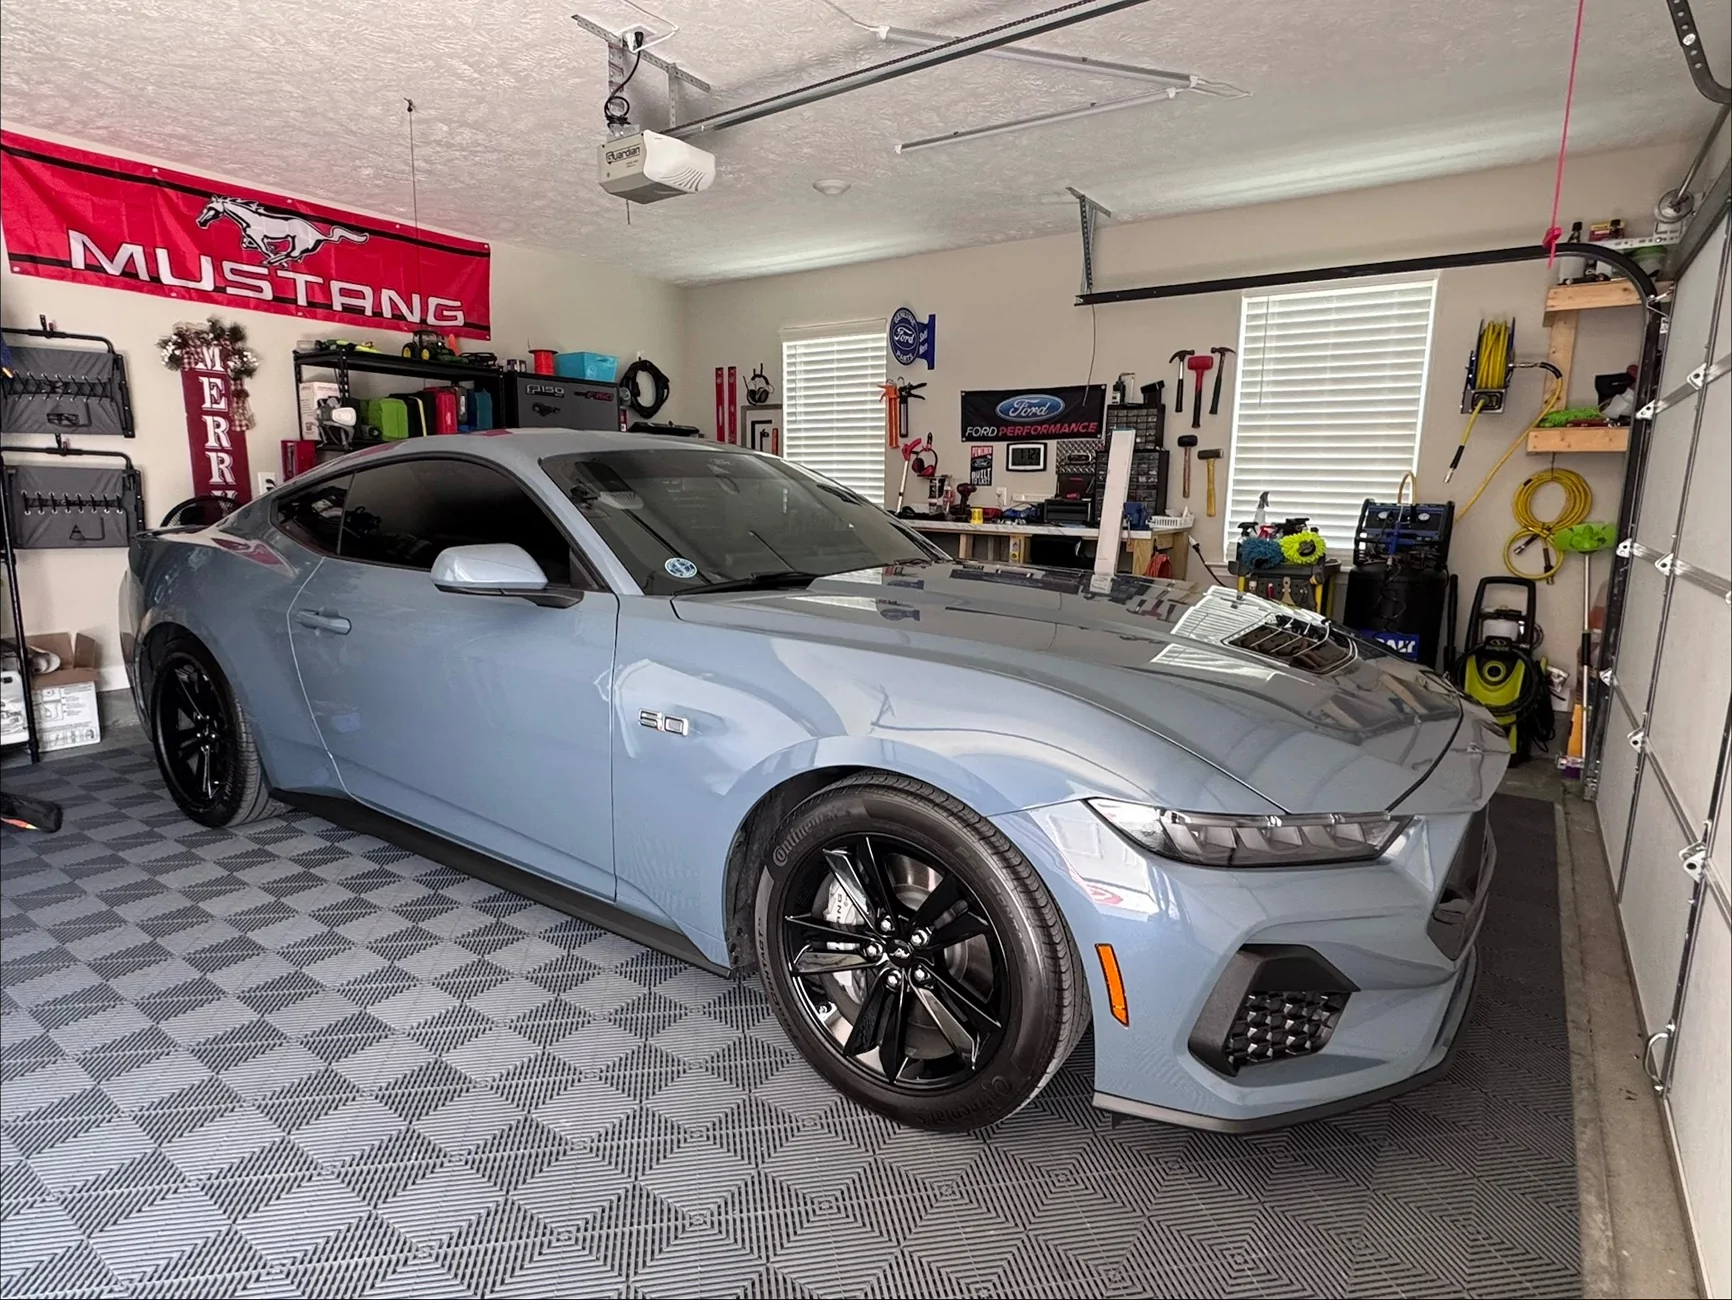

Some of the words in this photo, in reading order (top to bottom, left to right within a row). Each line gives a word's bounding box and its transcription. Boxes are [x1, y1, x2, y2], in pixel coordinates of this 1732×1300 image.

[606, 146, 640, 164] Guardian
[67, 229, 465, 328] MUSTANG
[894, 327, 915, 344] Ford
[1008, 398, 1050, 417] Ford
[965, 426, 998, 437] FORD
[999, 422, 1099, 437] PERFORMANCE
